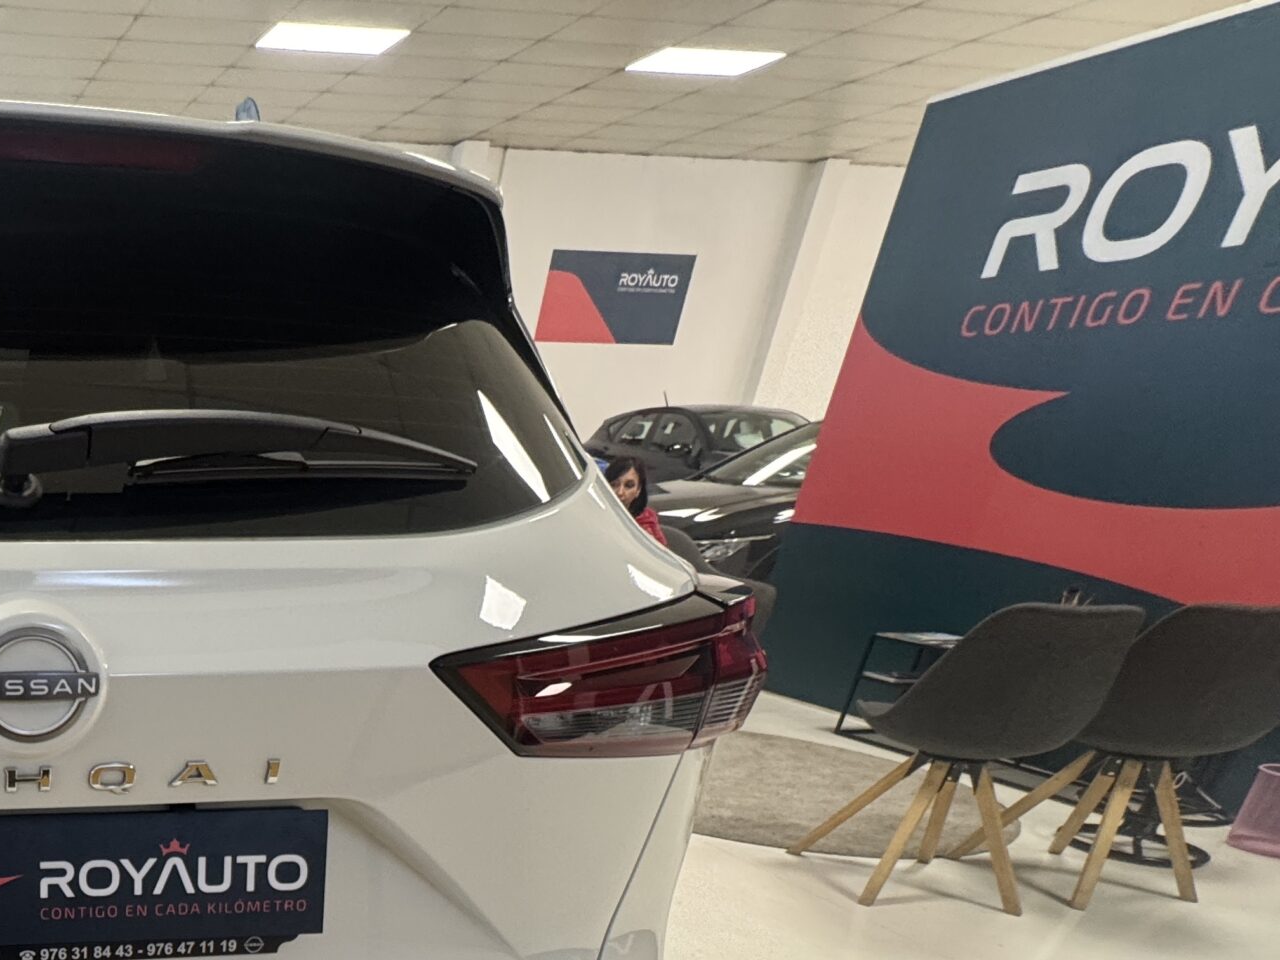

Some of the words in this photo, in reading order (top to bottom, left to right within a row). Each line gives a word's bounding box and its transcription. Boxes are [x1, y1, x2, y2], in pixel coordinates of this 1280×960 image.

[619, 272, 679, 288] ROYAUTO
[960, 287, 1152, 338] CONTIGO
[1165, 278, 1244, 321] EN
[39, 854, 309, 899] ROYAUTO
[40, 904, 118, 921] CONTIGO
[125, 903, 148, 917] EN
[155, 902, 200, 916] CADA
[207, 899, 308, 914] KILÓMETRO
[71, 947, 88, 960] 31
[93, 946, 112, 959] 84
[115, 944, 133, 957] 43
[147, 943, 173, 956] 976
[176, 941, 195, 955] 47
[199, 940, 215, 953] 11
[219, 939, 238, 952] 19
